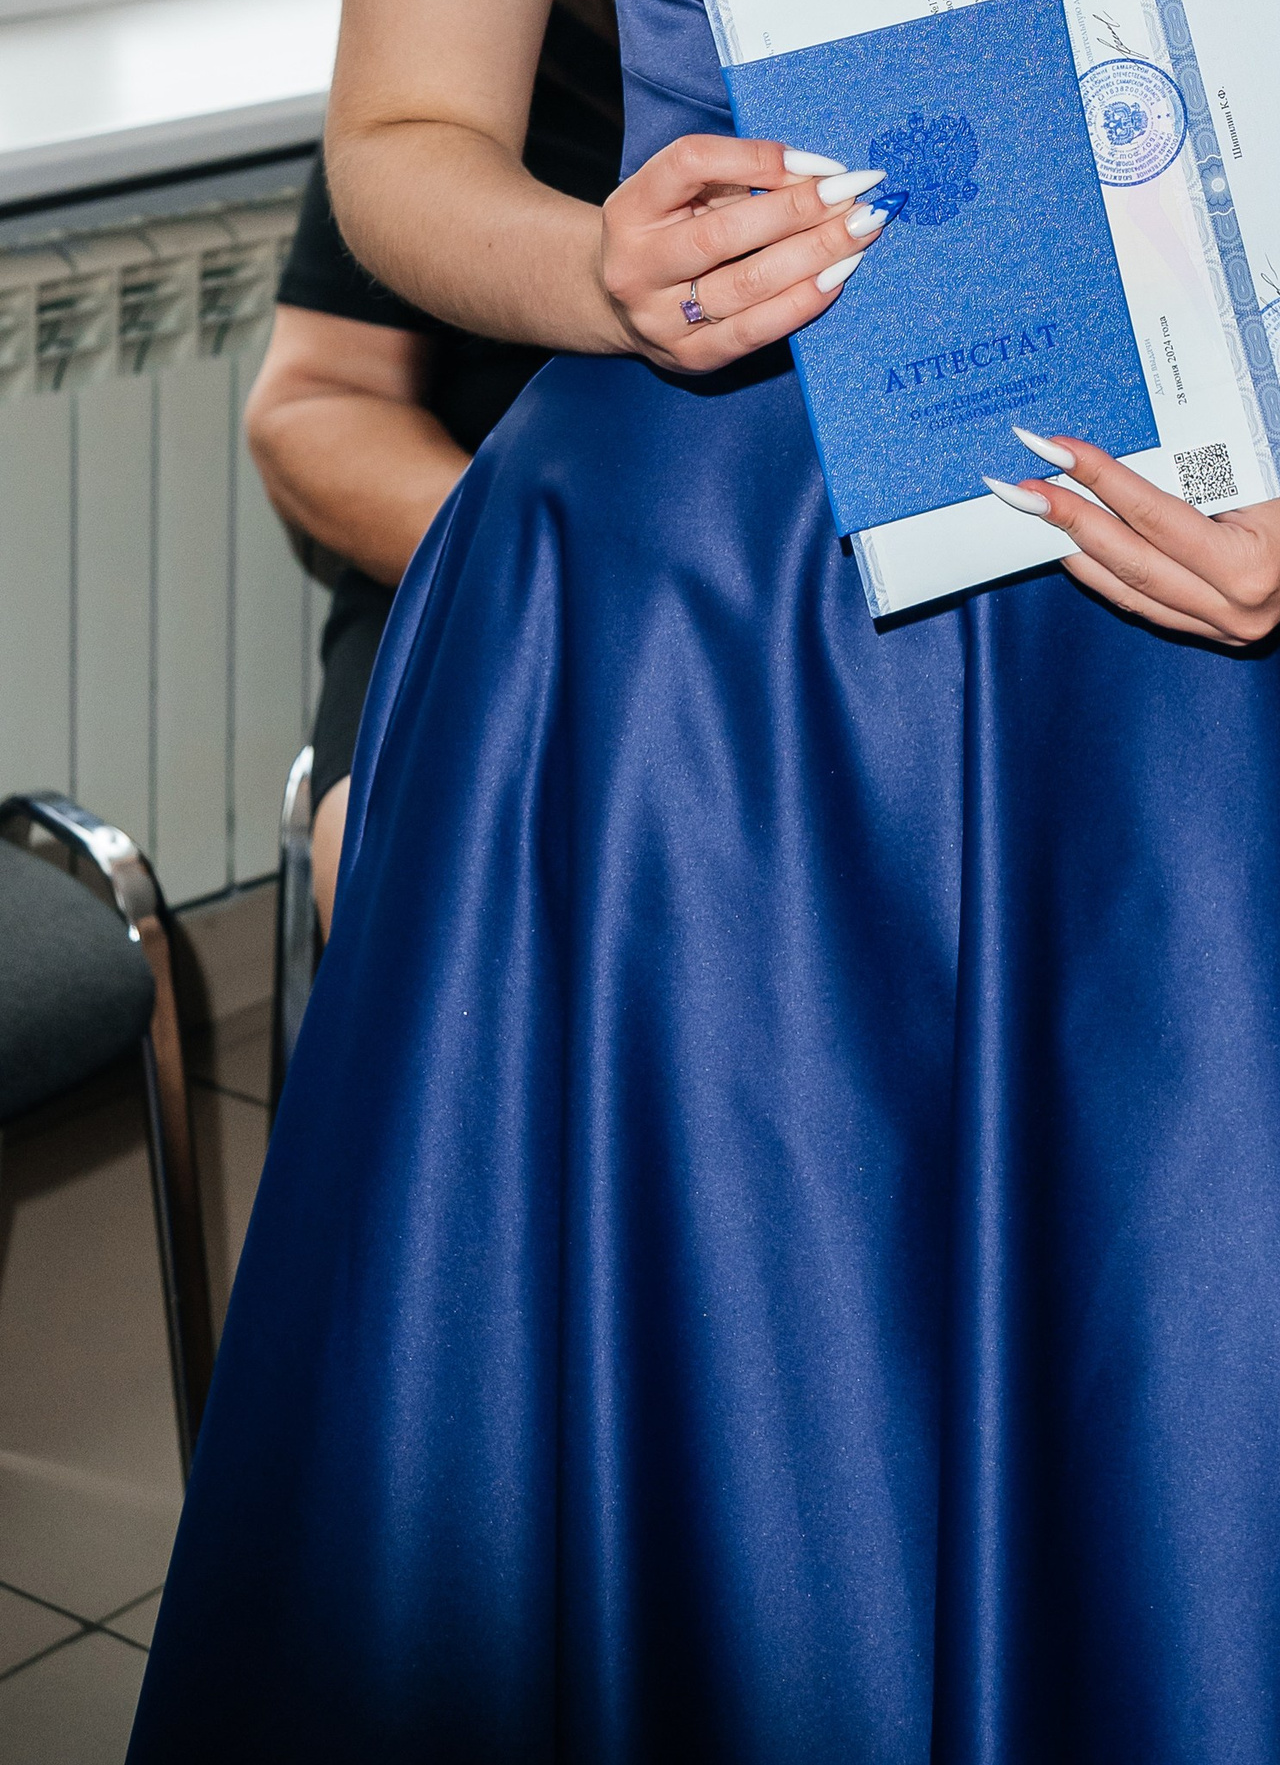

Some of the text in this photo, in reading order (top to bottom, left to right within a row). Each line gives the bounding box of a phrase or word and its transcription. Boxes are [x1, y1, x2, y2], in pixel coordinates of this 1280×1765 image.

[1216, 86, 1241, 159] Шипилин К.Ф.
[885, 323, 1057, 394] АТТЕСТАТ
[1142, 337, 1164, 397] Дата выдачи
[1158, 315, 1187, 405] 28 июня 2024 года
